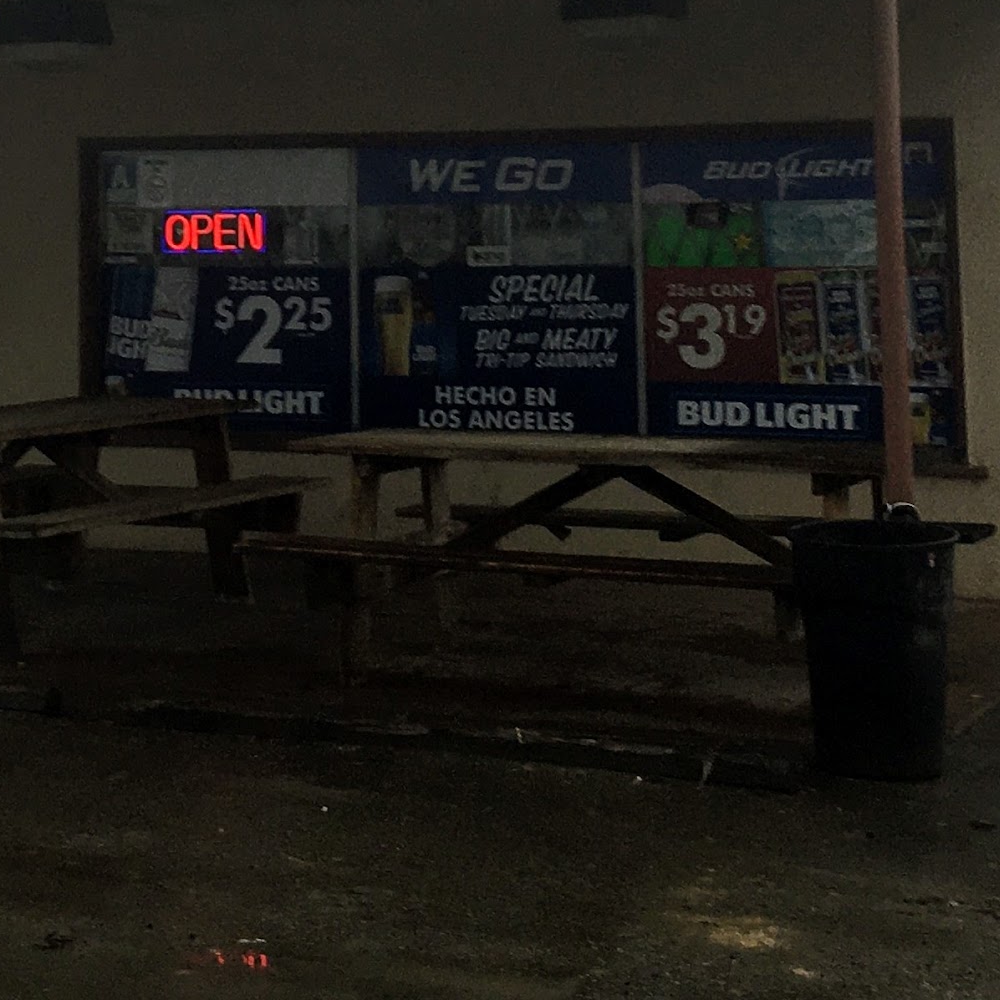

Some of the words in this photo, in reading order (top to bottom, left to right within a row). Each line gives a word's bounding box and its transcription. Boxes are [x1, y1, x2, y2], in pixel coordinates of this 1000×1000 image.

[408, 158, 487, 193] WE
[495, 156, 575, 192] GO
[702, 159, 773, 180] BUD
[163, 212, 265, 252] OPEN
[272, 275, 320, 292] CANS
[488, 273, 601, 304] SPECIAL
[710, 283, 756, 298] CANS
[474, 328, 512, 351] BIG
[541, 327, 619, 351] MEATY
[434, 385, 516, 406] HECHO
[524, 387, 557, 407] EN
[418, 409, 461, 429] LOS
[468, 410, 575, 432] ANGELES
[676, 399, 751, 428] BUD
[754, 401, 861, 431] LIGHT
